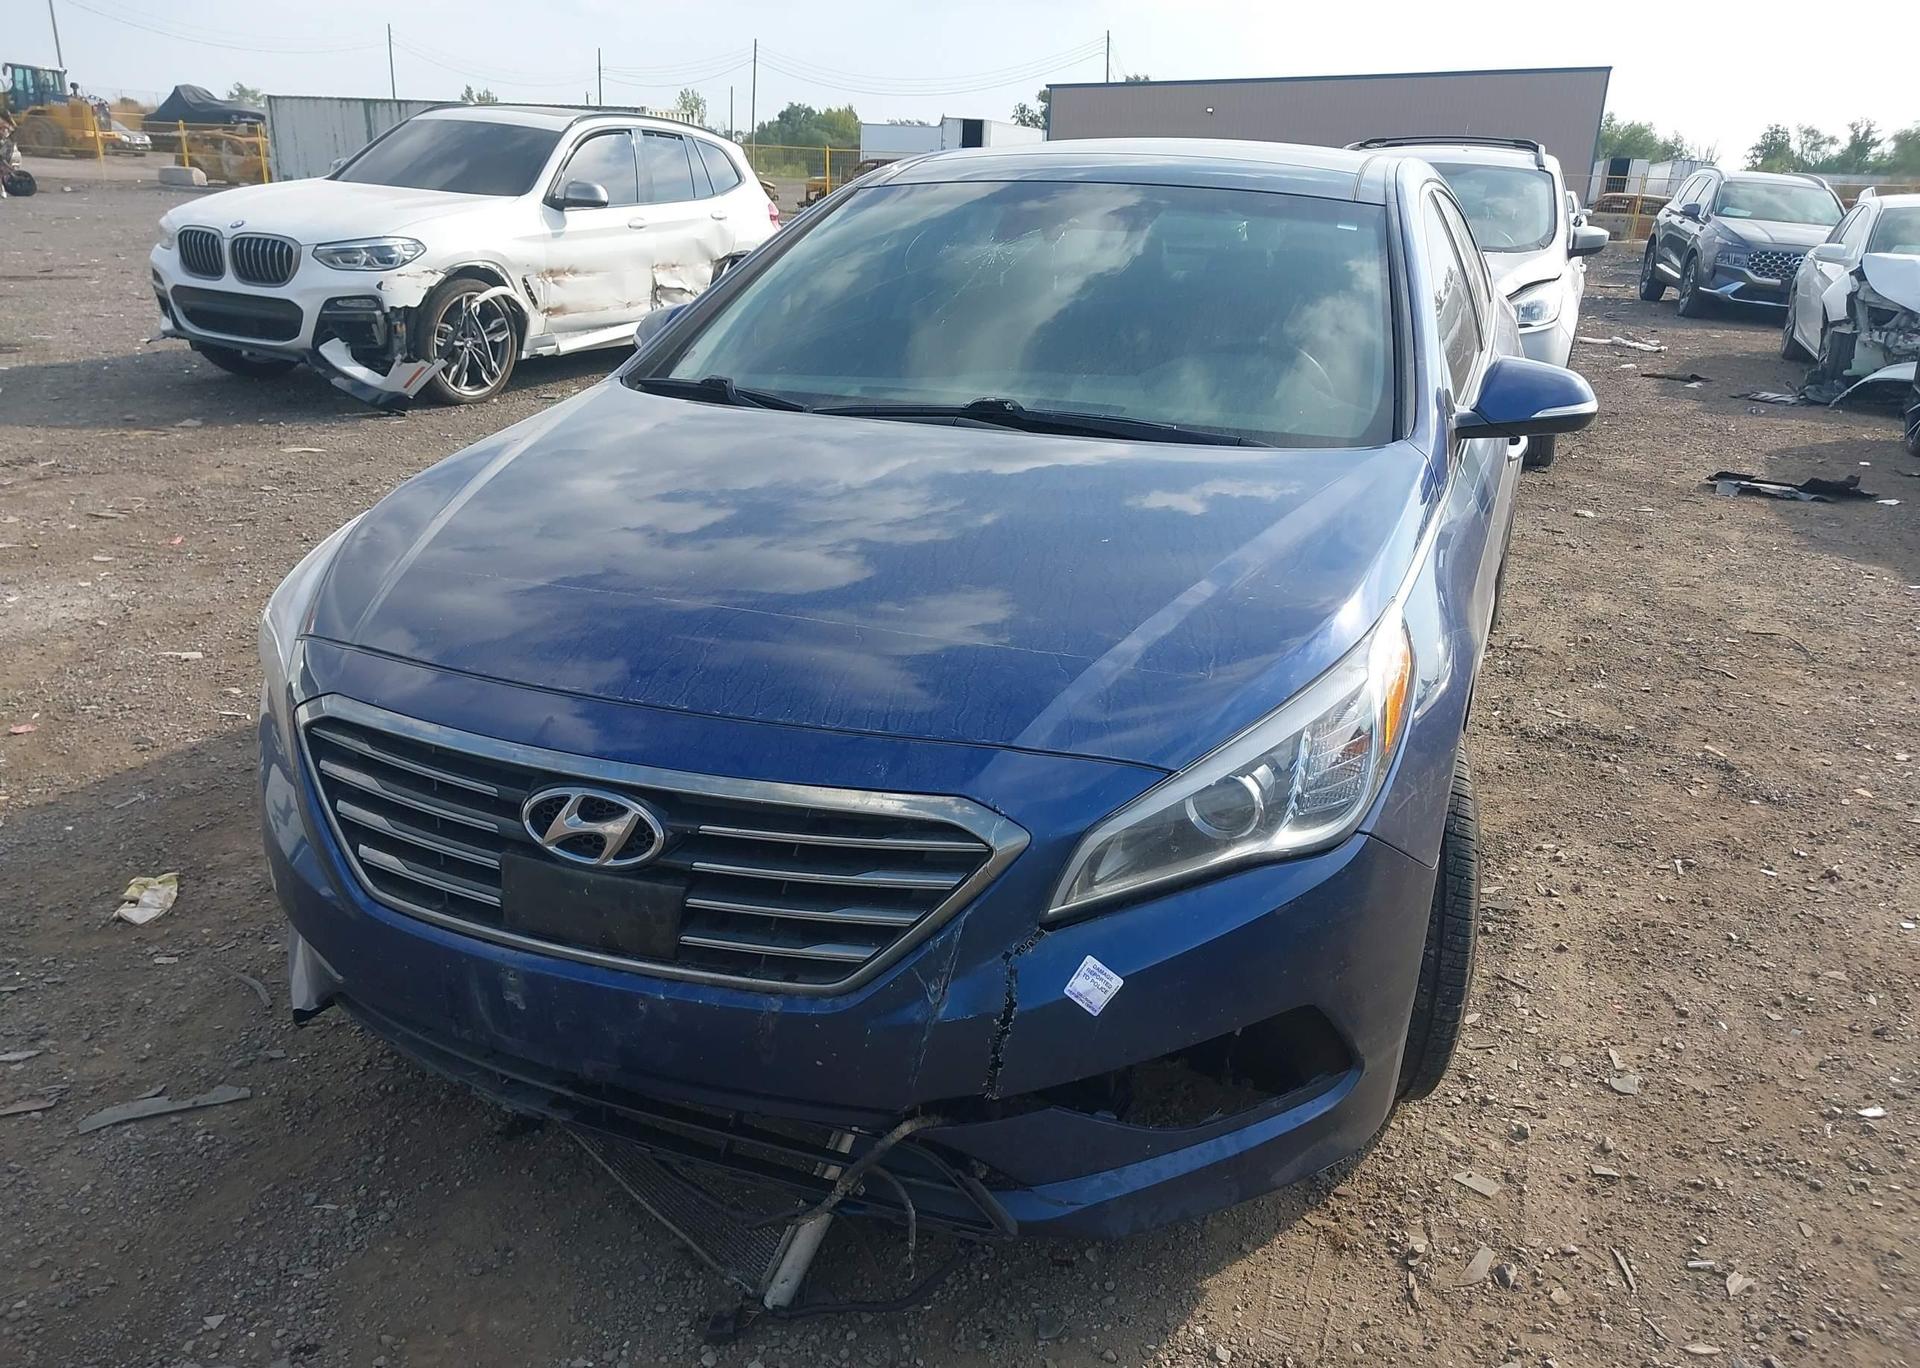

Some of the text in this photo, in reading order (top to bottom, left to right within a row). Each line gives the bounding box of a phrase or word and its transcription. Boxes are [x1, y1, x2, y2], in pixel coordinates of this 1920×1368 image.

[1086, 967, 1112, 989] REPORTED
[1093, 964, 1113, 982] DAMAGE
[1090, 979, 1109, 995] POLICE
